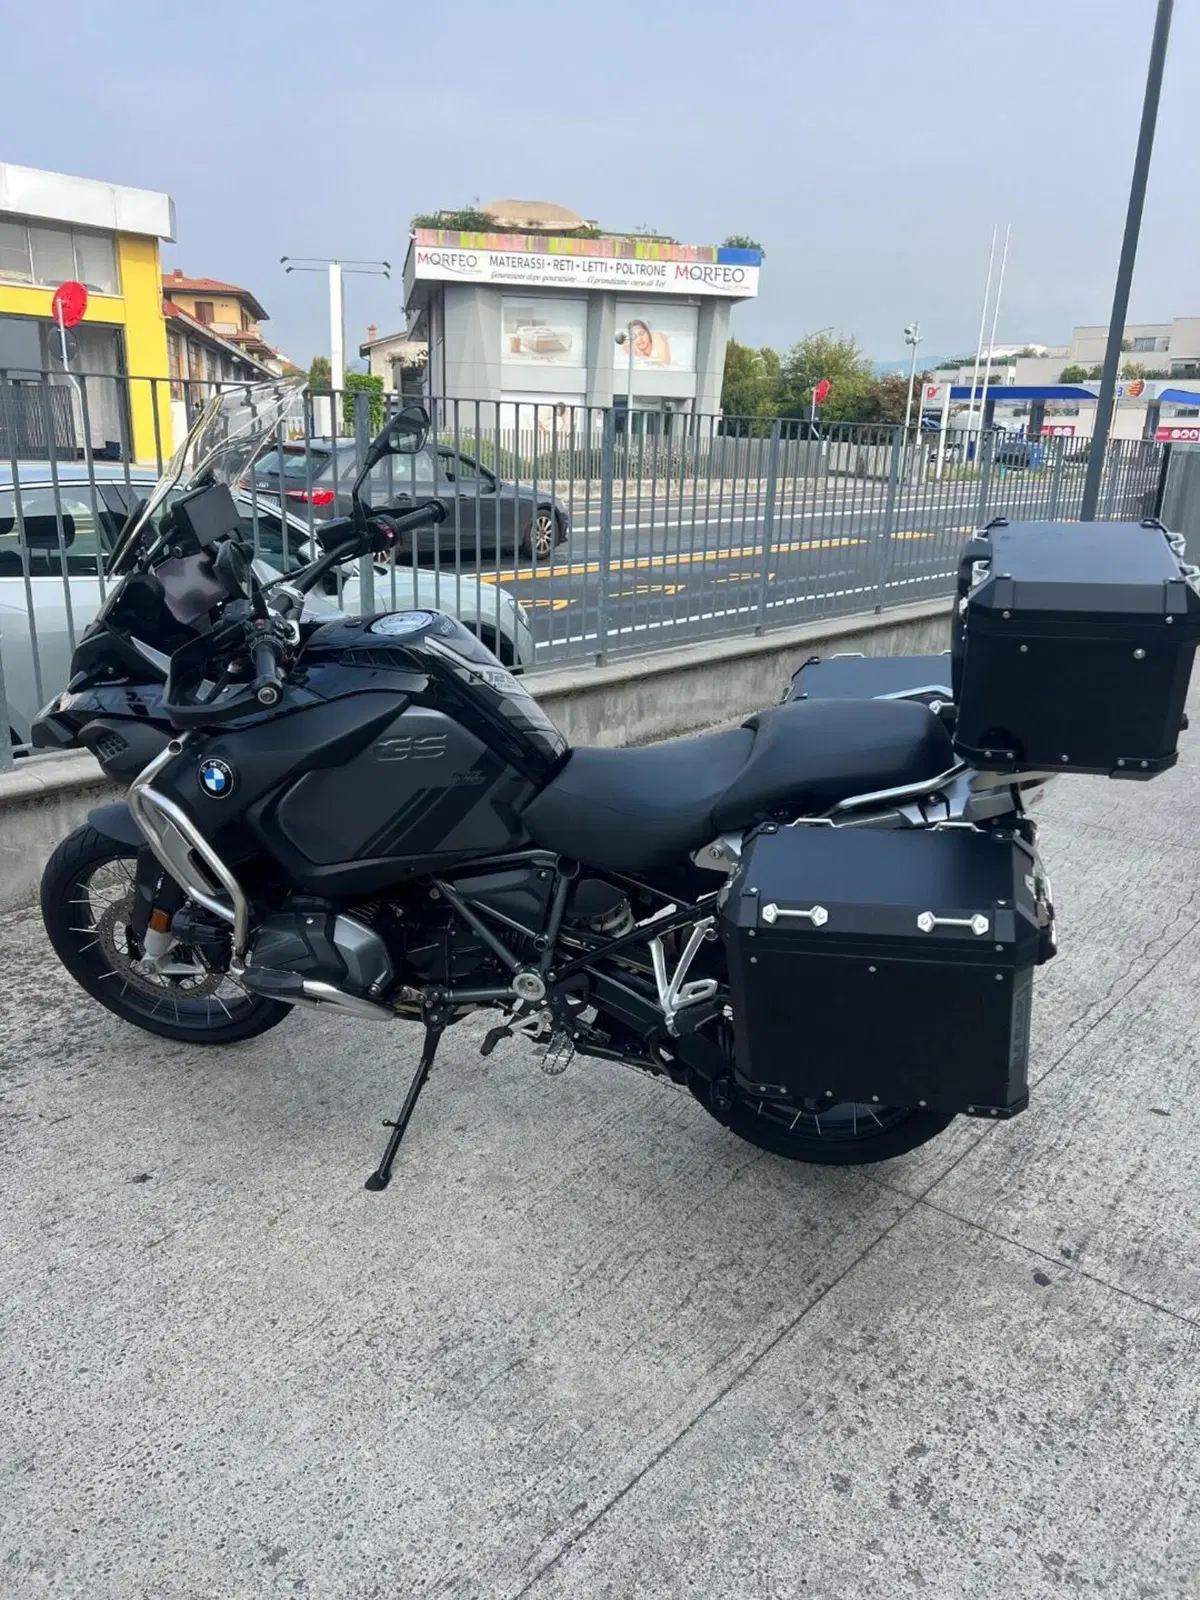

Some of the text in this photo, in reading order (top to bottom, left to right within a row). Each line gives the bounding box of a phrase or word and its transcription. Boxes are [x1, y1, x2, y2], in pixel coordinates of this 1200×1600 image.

[417, 252, 478, 268] MORFEO
[489, 255, 667, 277] MATERASSI RETI LETTI POLTRONE
[674, 264, 745, 283] MORFEO
[373, 733, 448, 762] GS
[201, 761, 228, 773] BMW
